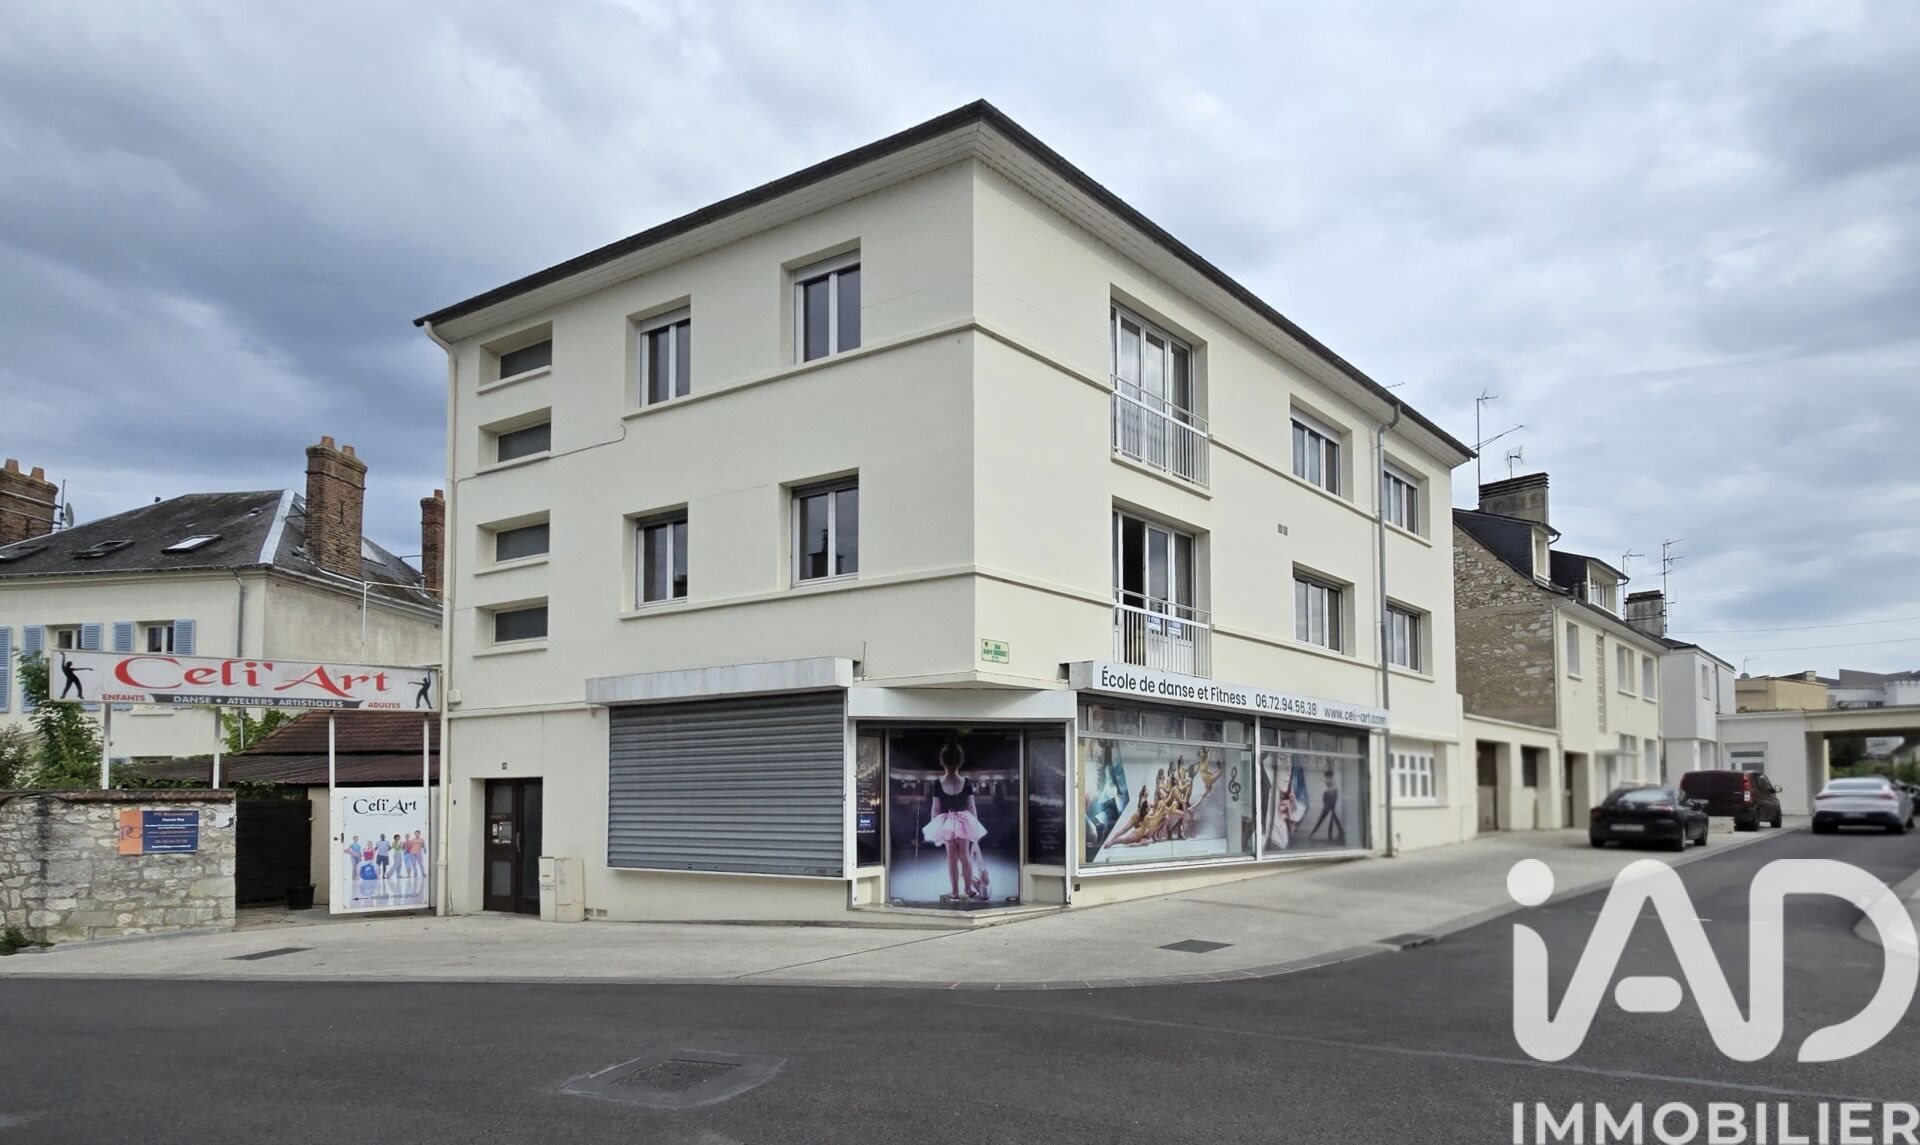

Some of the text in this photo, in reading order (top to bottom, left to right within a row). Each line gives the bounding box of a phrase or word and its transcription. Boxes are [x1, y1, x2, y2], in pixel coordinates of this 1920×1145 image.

[102, 693, 401, 709] ENFANTS DANSE ATELIERS ARTISTIQUES ADULTES
[1101, 665, 1387, 725] École de danse et Fitness 06.72.94.56.38 www.celi-art.com
